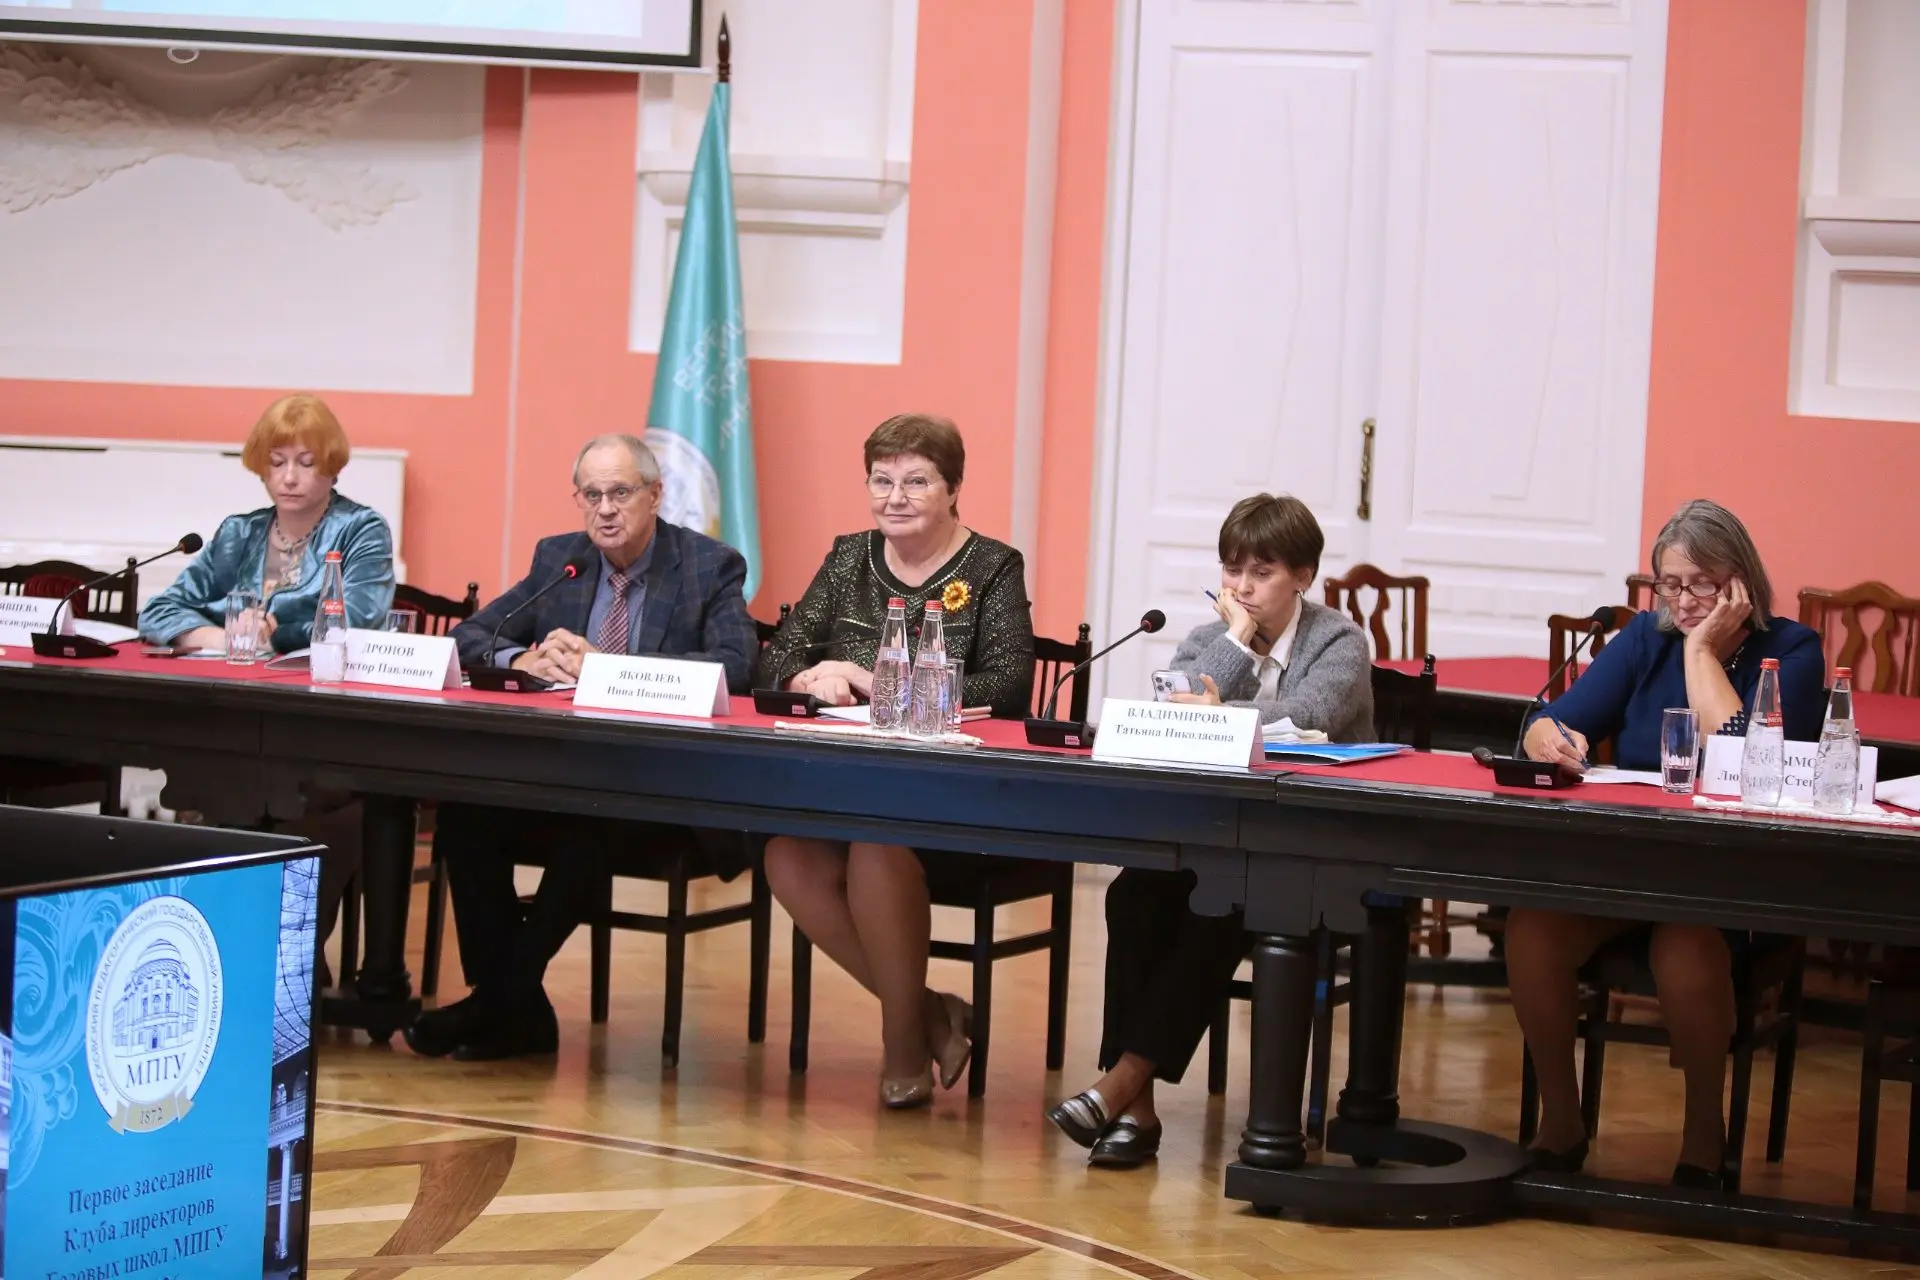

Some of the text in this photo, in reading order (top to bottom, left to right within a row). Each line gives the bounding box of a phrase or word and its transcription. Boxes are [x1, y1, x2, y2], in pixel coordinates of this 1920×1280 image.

[362, 643, 415, 657] ДРОНОВ
[345, 661, 434, 678] иктор Павлович
[618, 670, 682, 684] ЯКОВЛЕВА
[607, 686, 687, 701] Нина Ивановна
[1127, 707, 1228, 724] ВЛАДИМИРОВА
[1115, 724, 1234, 743] Татьяна Николаевна
[125, 1052, 187, 1089] МПГУ
[140, 1107, 163, 1125] 1872
[69, 1162, 214, 1216] Первое заседание
[64, 1198, 215, 1253] Клуба директоров
[124, 1247, 169, 1274] школ
[173, 1224, 229, 1261] МПГУ
